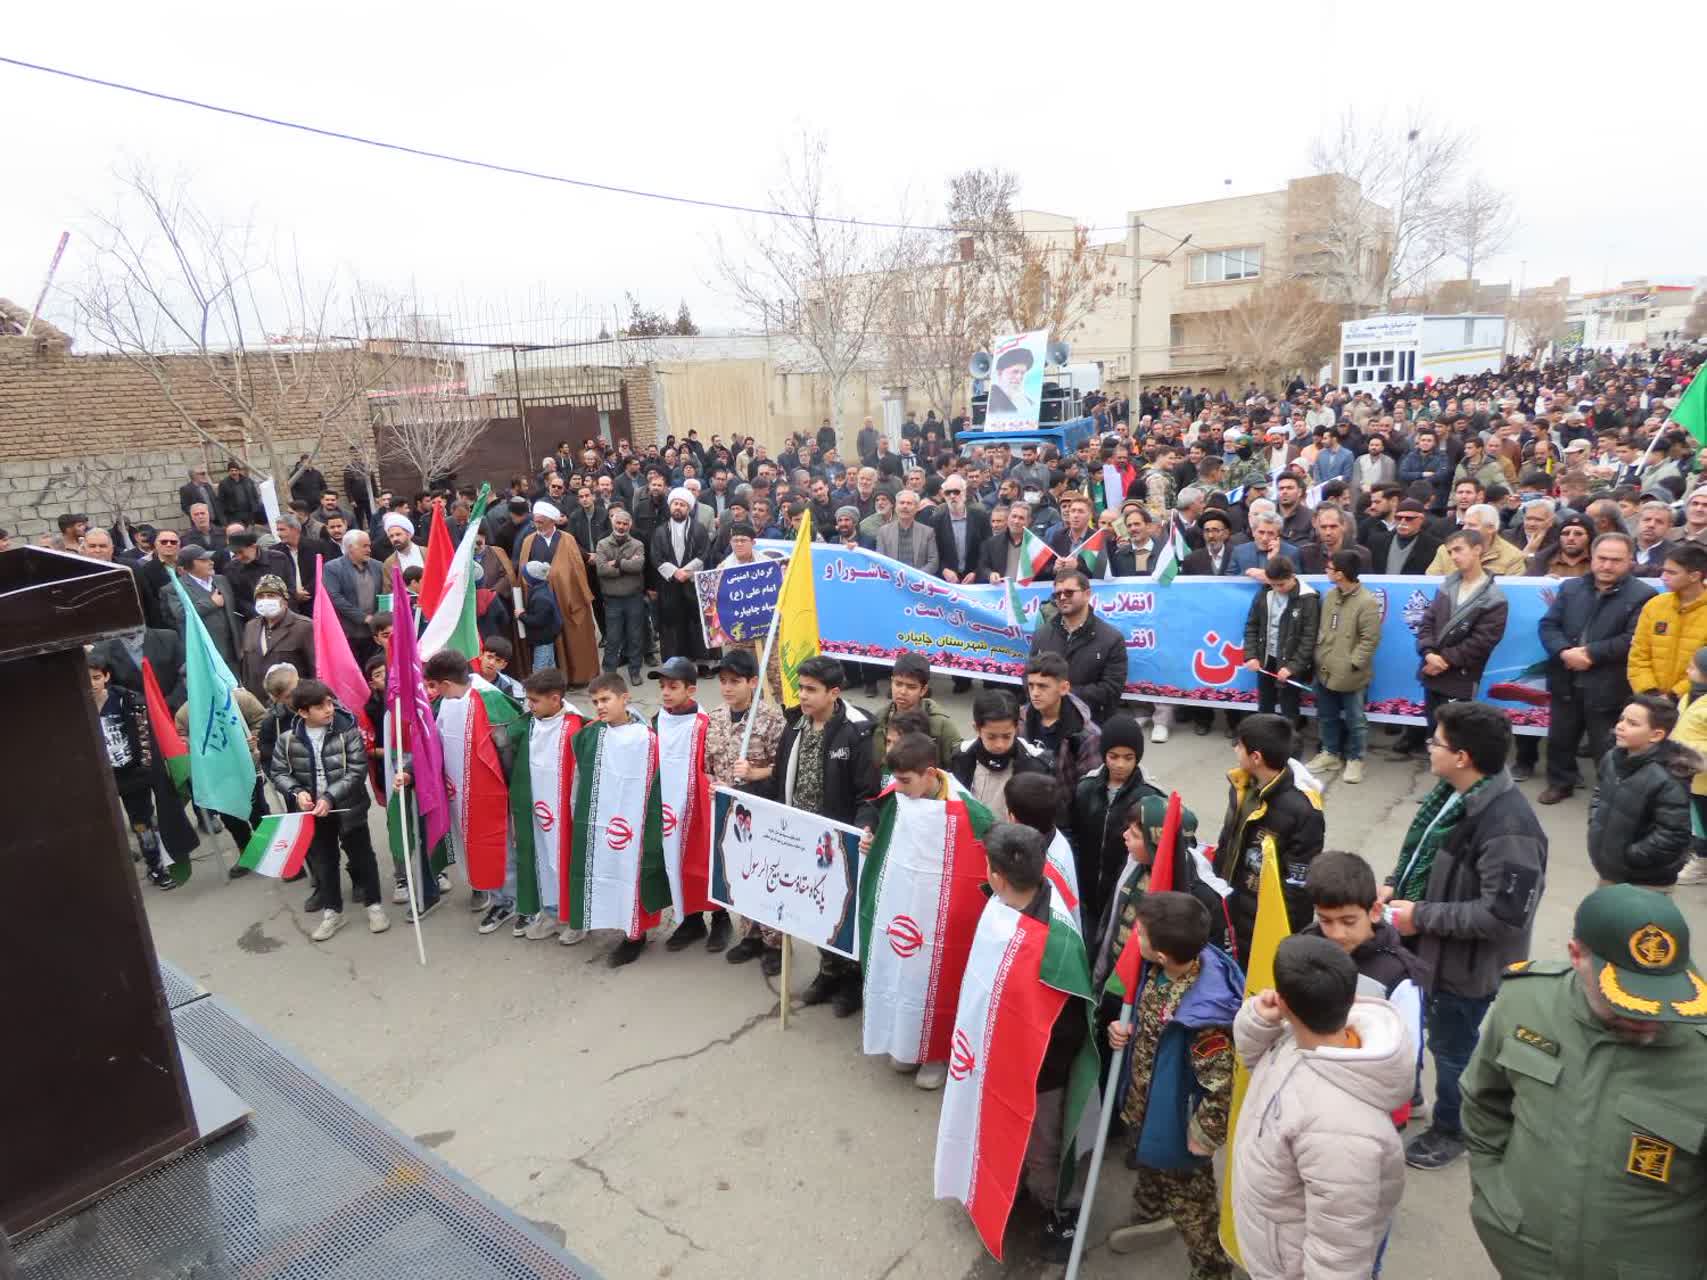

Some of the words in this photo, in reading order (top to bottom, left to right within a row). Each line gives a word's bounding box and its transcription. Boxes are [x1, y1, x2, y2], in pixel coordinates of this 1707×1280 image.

[825, 564, 834, 580] و
[836, 559, 890, 583] عاشورا
[895, 569, 906, 588] از
[746, 587, 761, 599] علی
[762, 584, 777, 596] امام
[1102, 591, 1153, 616] انقلاب
[947, 608, 965, 628] آن
[936, 635, 988, 652] شهرستان
